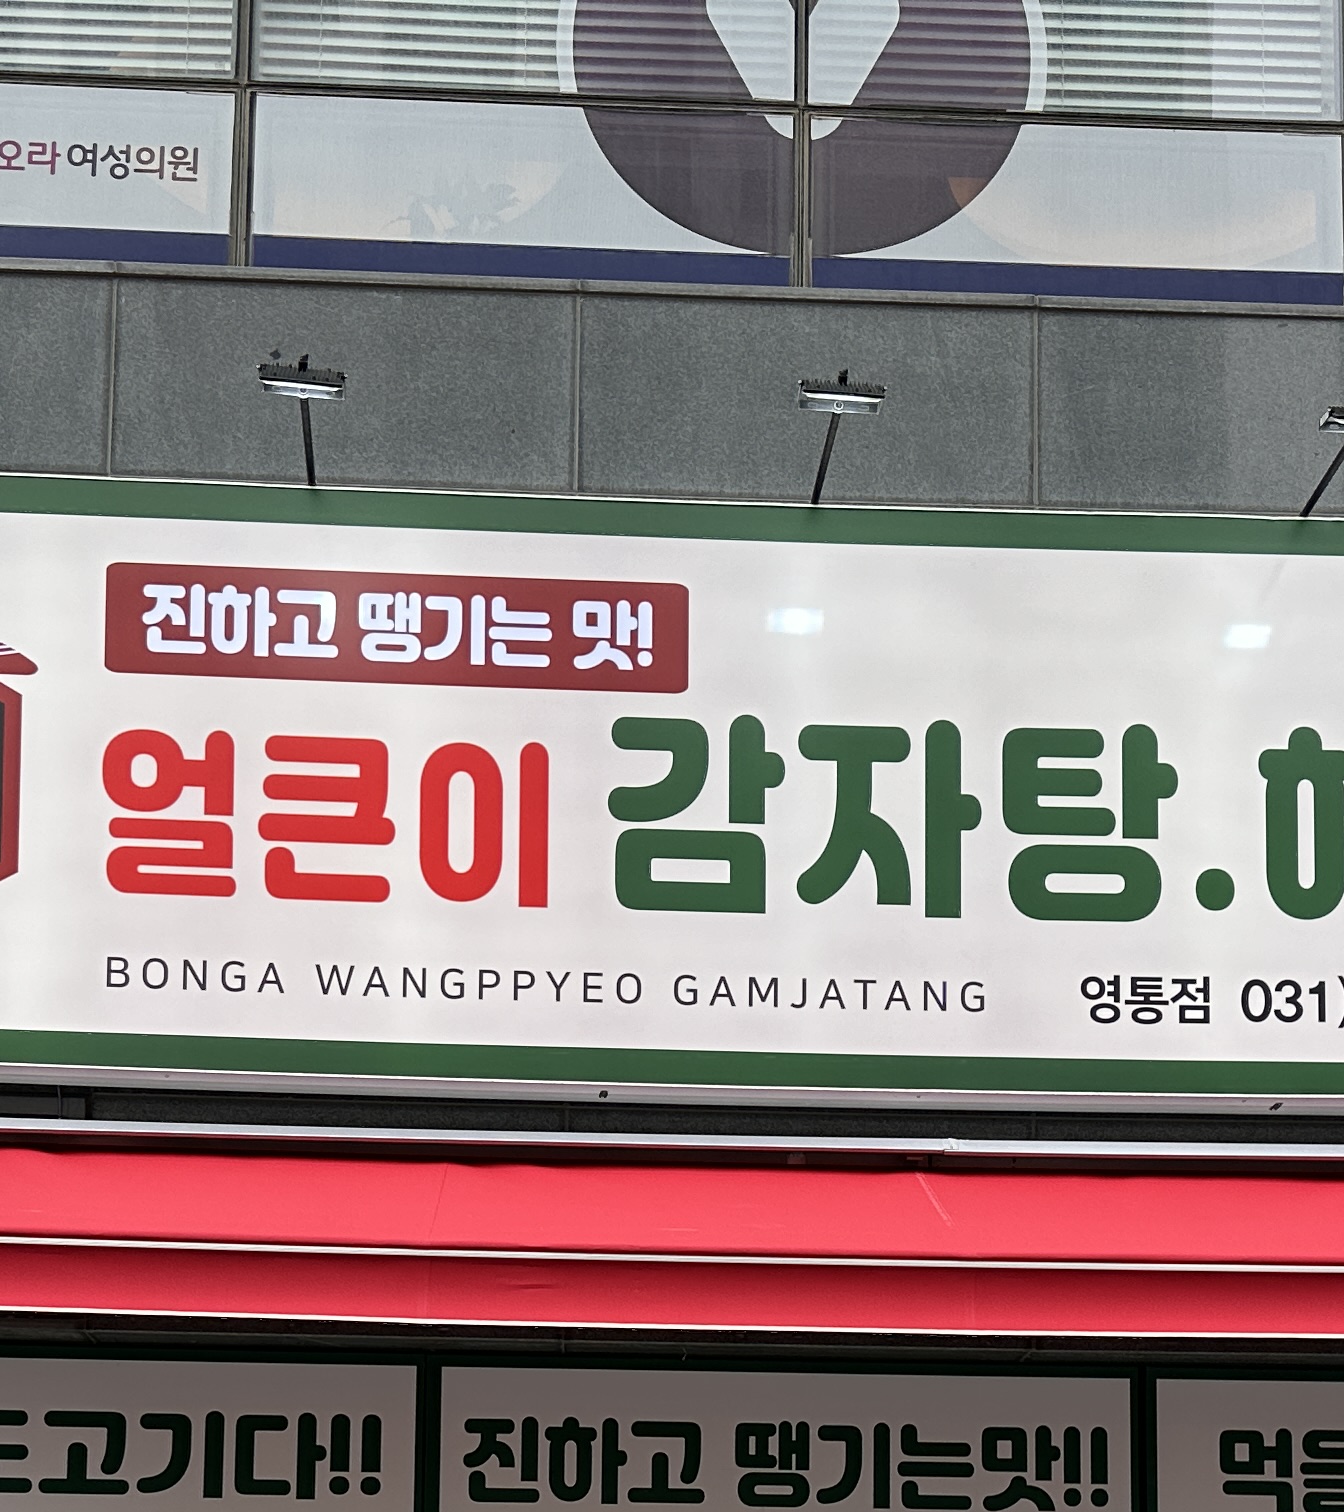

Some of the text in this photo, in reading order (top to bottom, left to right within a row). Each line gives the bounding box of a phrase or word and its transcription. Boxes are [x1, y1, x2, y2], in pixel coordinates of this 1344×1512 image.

[66, 142, 199, 183] 여성의원
[140, 582, 654, 673] 진하고 땡기는 맛!
[101, 727, 550, 909] 얼큰이
[104, 954, 990, 1014] BONGA WANGPPYEO GAMJATANG
[1079, 972, 1211, 1026] 영통점
[462, 1415, 1110, 1512] 진하고 땡기는맛!!
